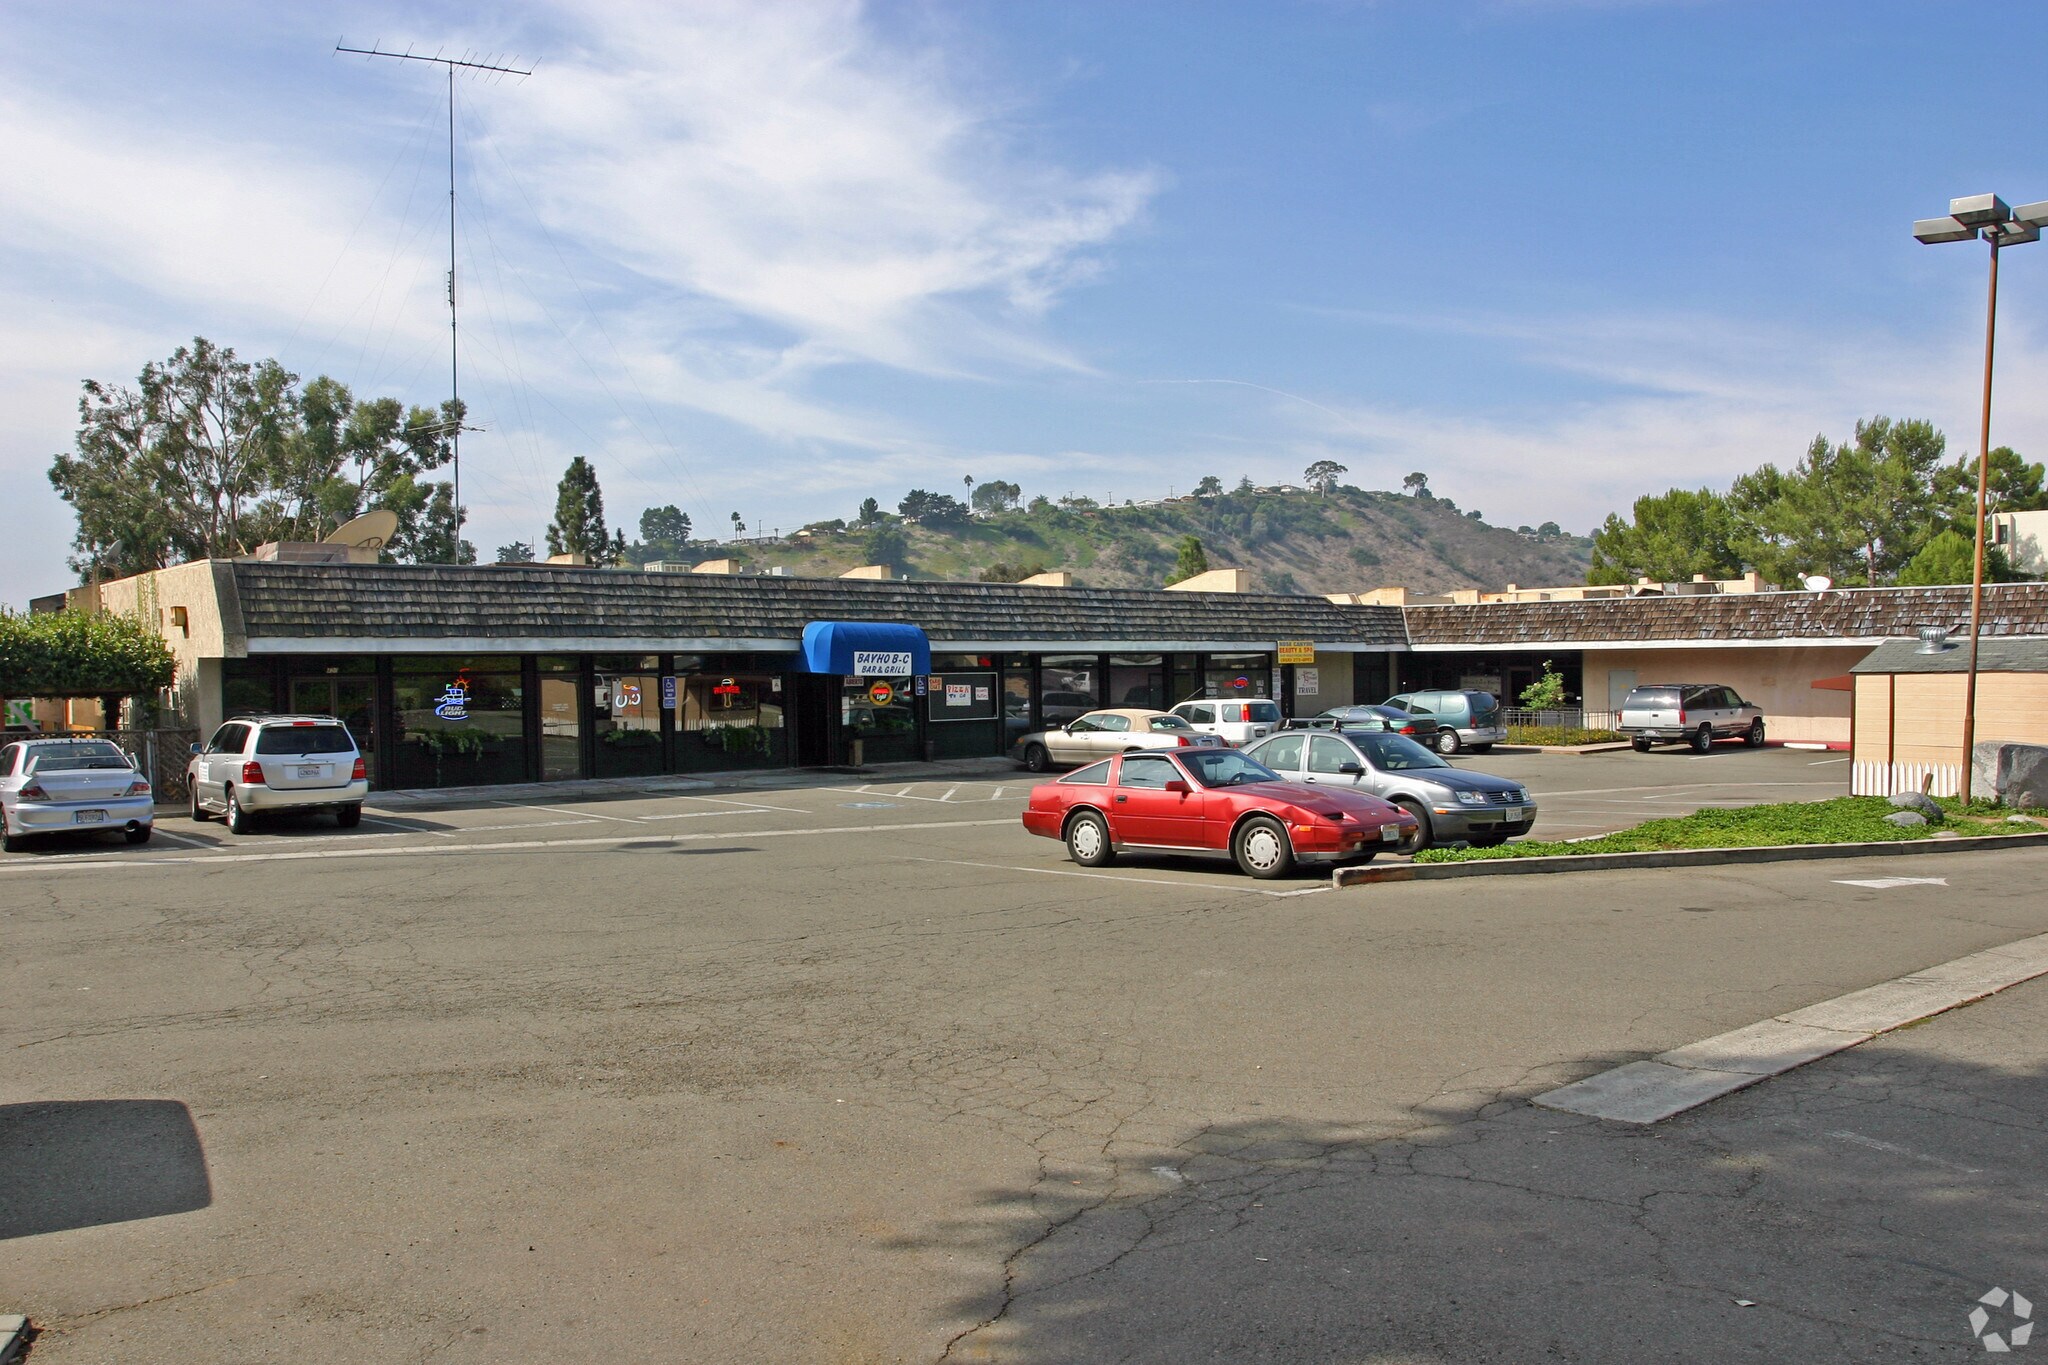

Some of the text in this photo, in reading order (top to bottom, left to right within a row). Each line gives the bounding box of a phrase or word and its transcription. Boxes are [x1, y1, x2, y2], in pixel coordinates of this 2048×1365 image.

[857, 653, 909, 664] BAYHO B-C
[861, 665, 906, 674] BAR & GRILL
[947, 685, 970, 693] PIZZA
